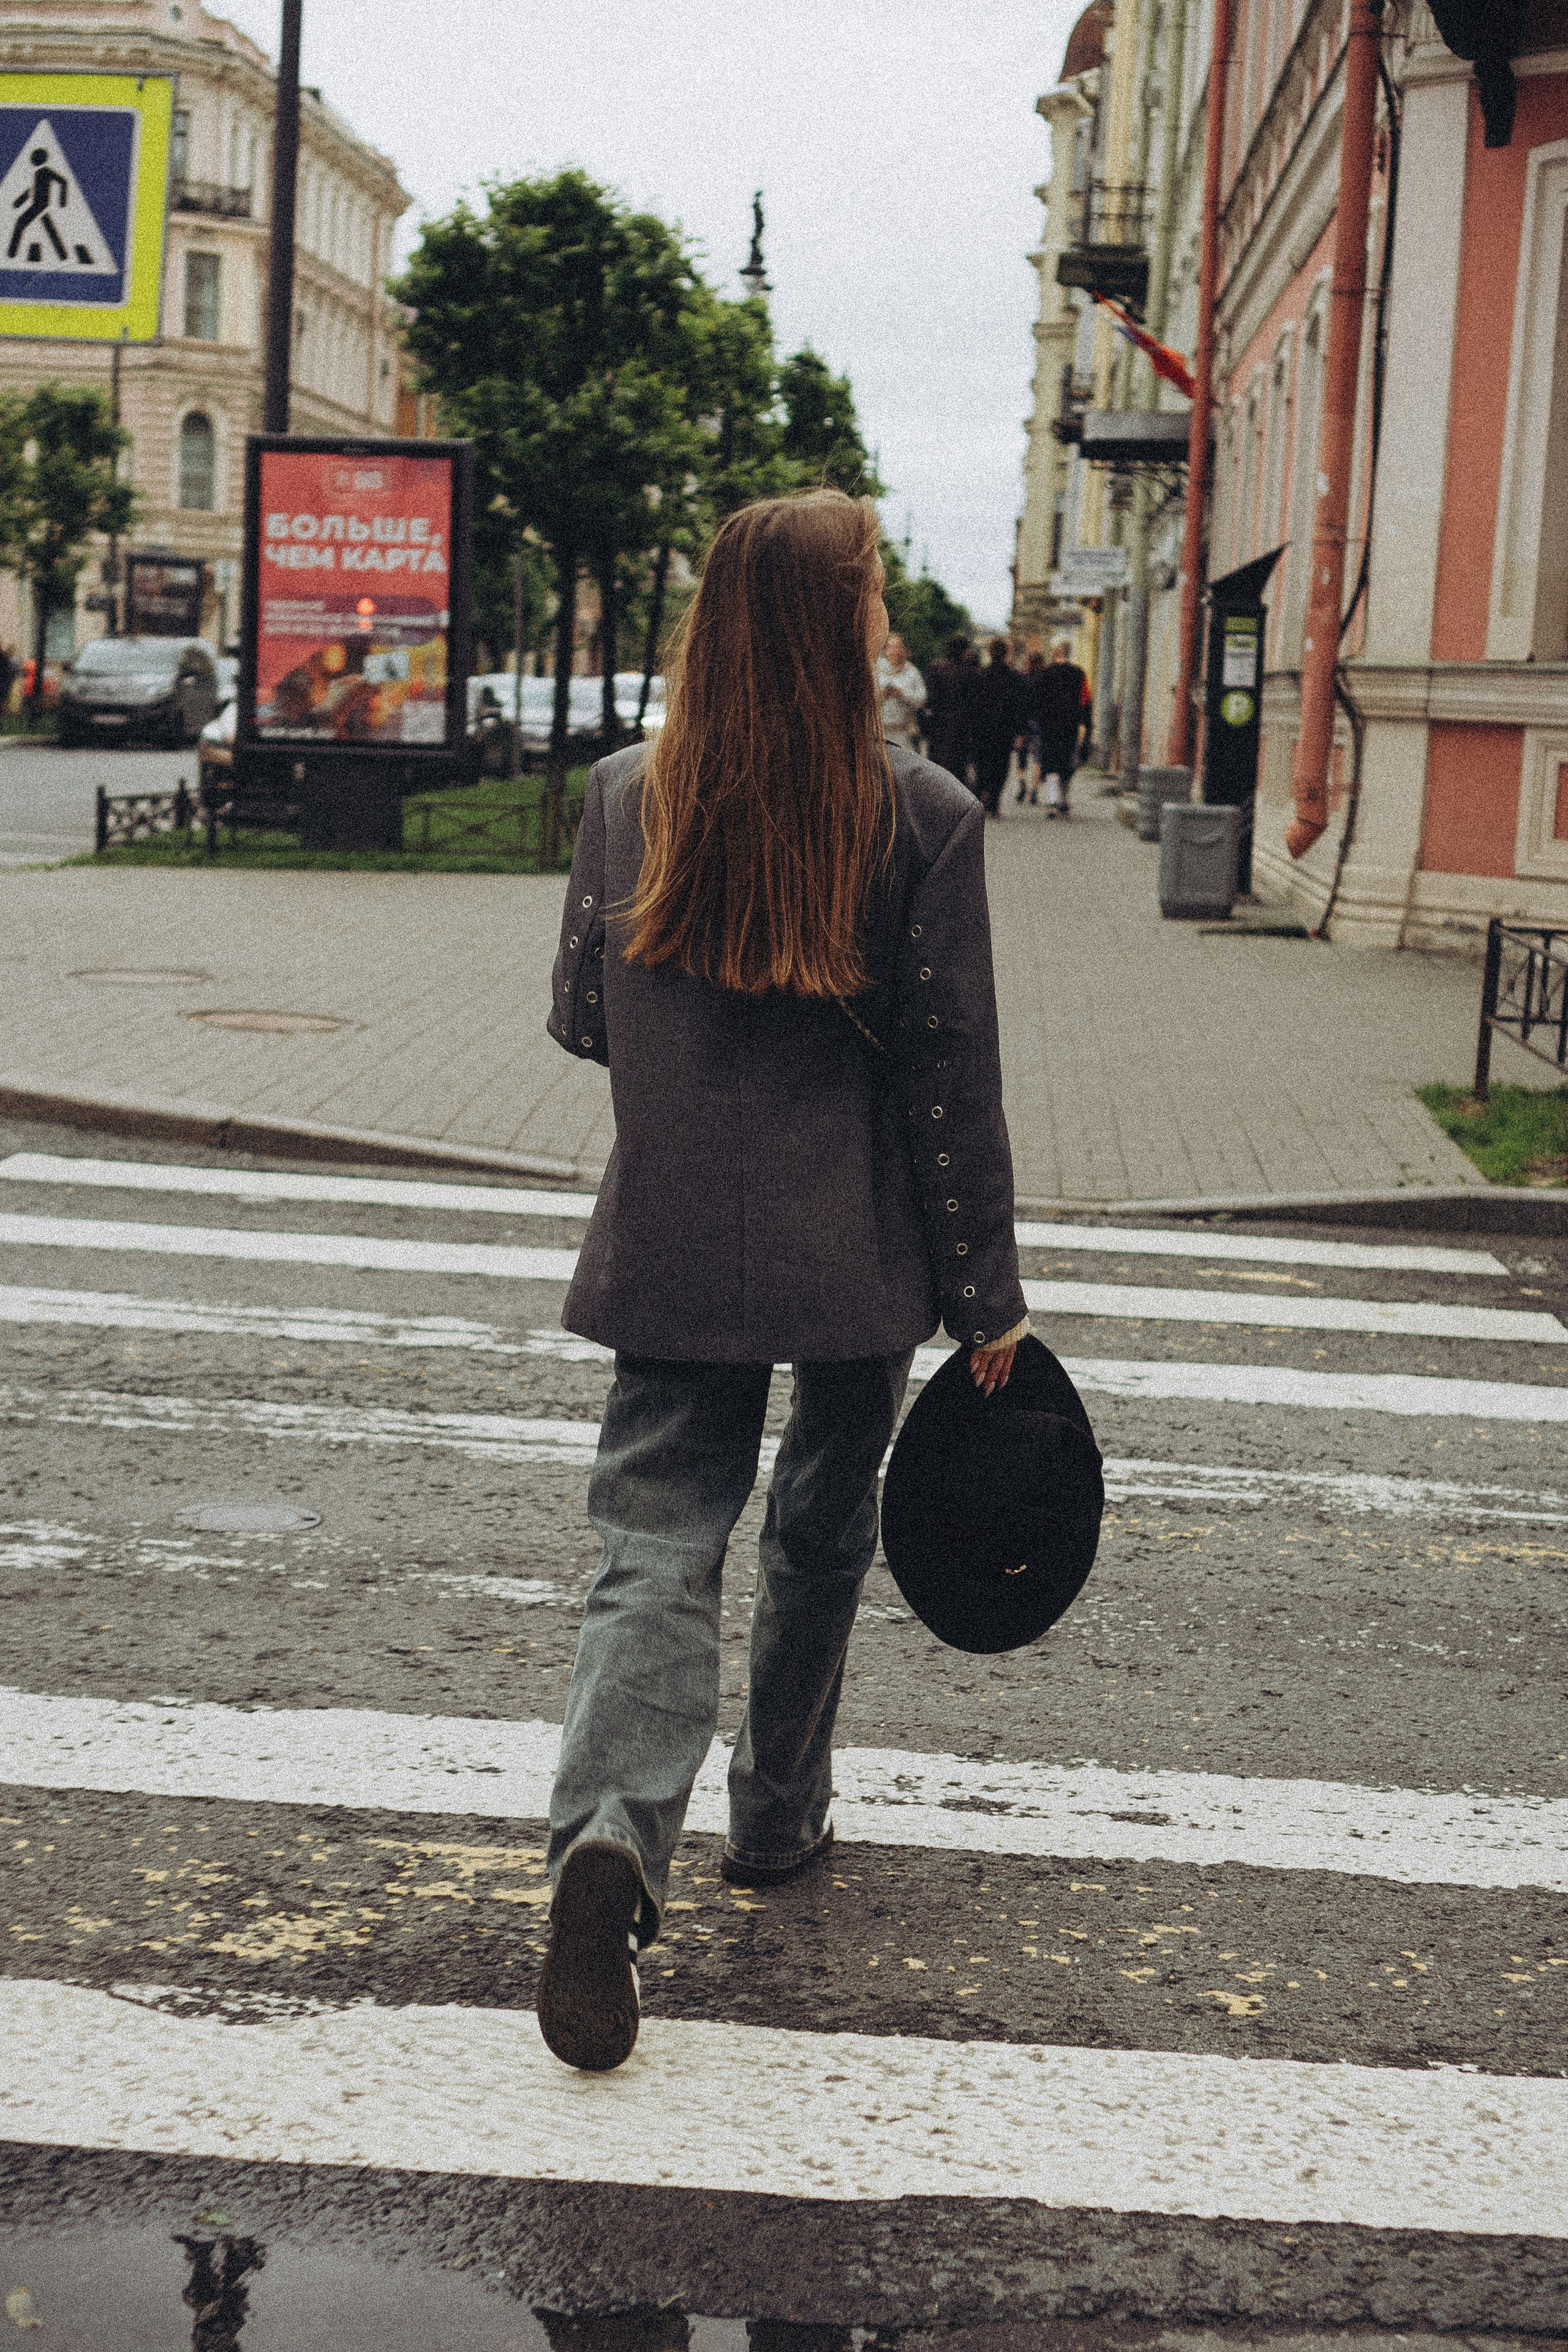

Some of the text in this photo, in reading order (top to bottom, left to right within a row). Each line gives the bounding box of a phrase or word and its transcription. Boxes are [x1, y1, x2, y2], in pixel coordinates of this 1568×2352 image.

[266, 513, 442, 545] БОЛЬШЕ,
[265, 546, 447, 572] ЧЕМ КАРТА
